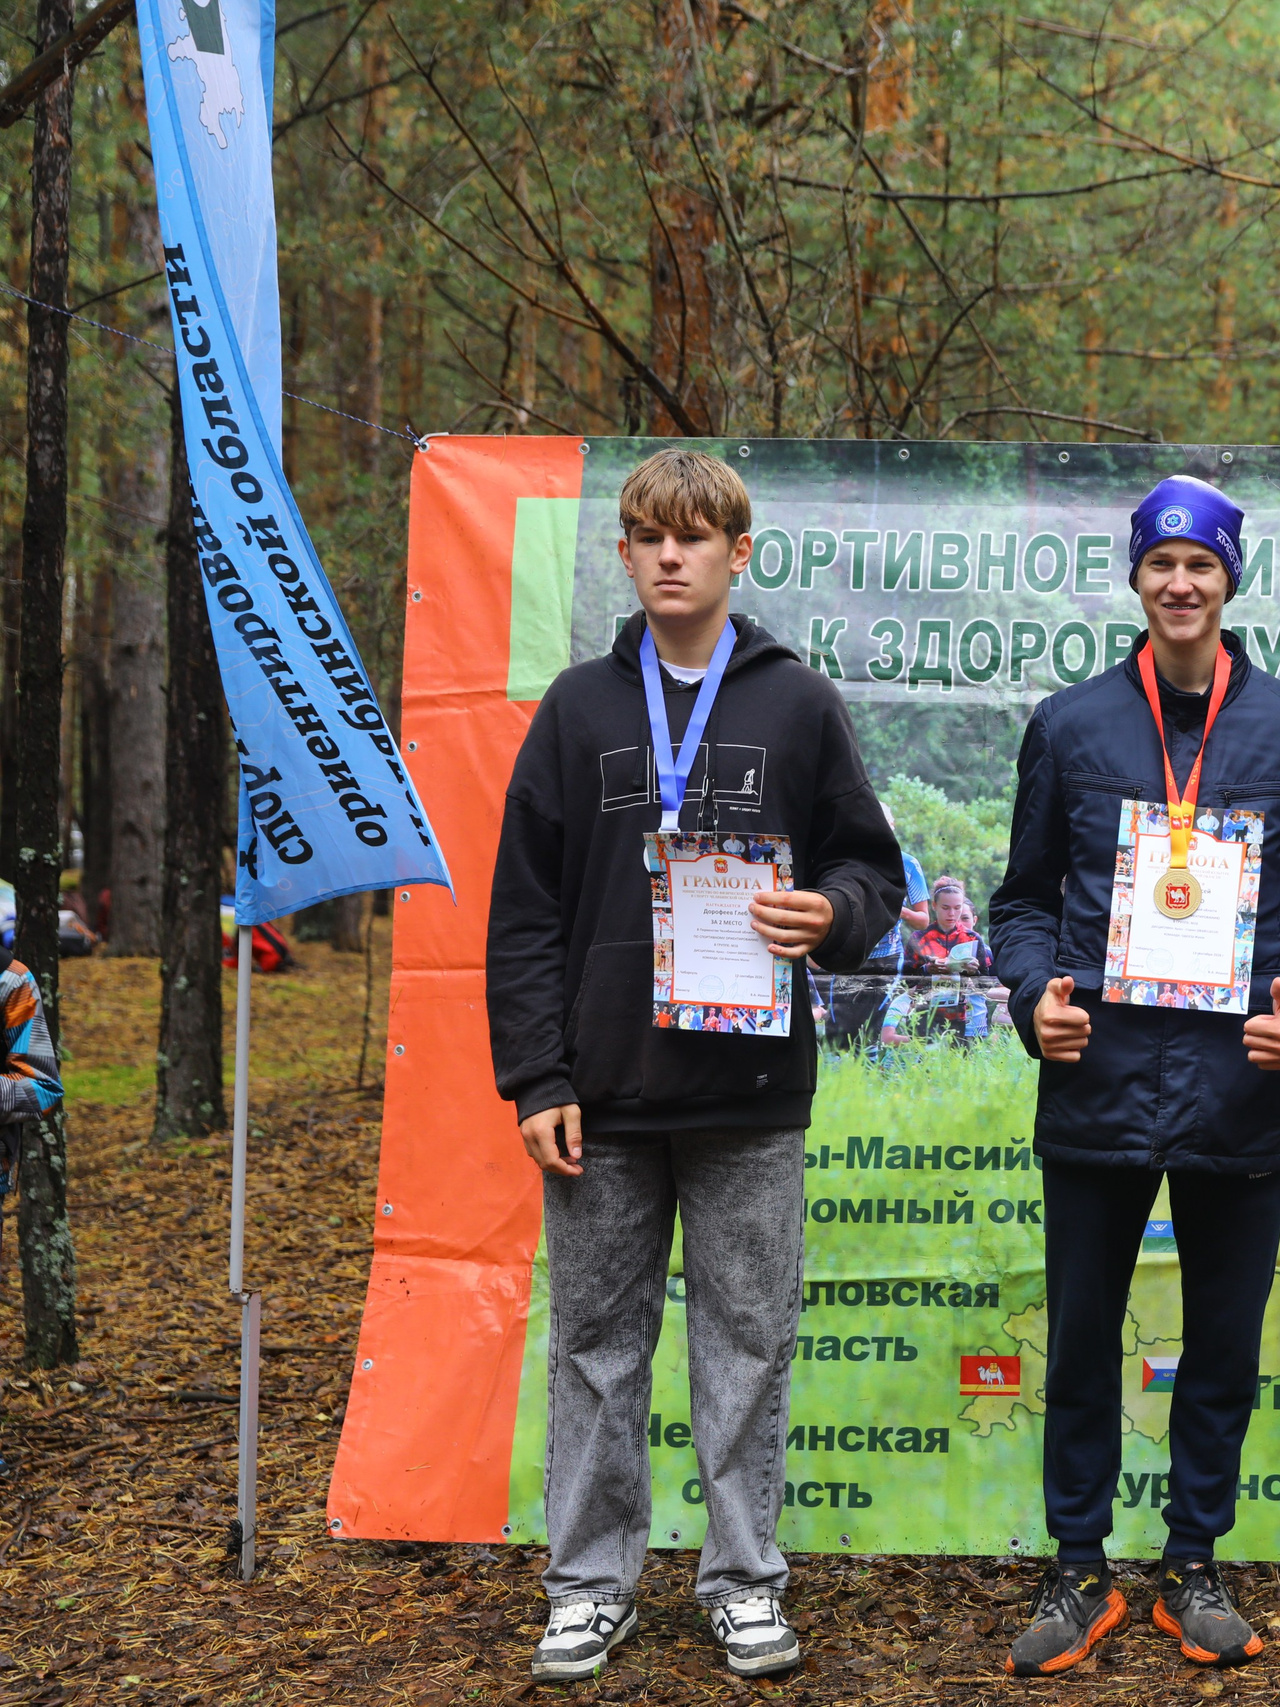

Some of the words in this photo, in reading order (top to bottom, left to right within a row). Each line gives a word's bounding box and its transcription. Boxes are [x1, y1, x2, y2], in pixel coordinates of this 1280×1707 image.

[162, 242, 264, 504] области
[729, 526, 1113, 597] ОРТИВНОЕ
[806, 616, 848, 680] К
[1149, 850, 1229, 869] ГРОТА
[682, 875, 763, 890] ГРАМОТА
[703, 908, 733, 916] Дорофеев
[804, 1135, 1044, 1171] ы-Мансий
[804, 1189, 975, 1225] омный
[790, 1334, 918, 1362] ласть
